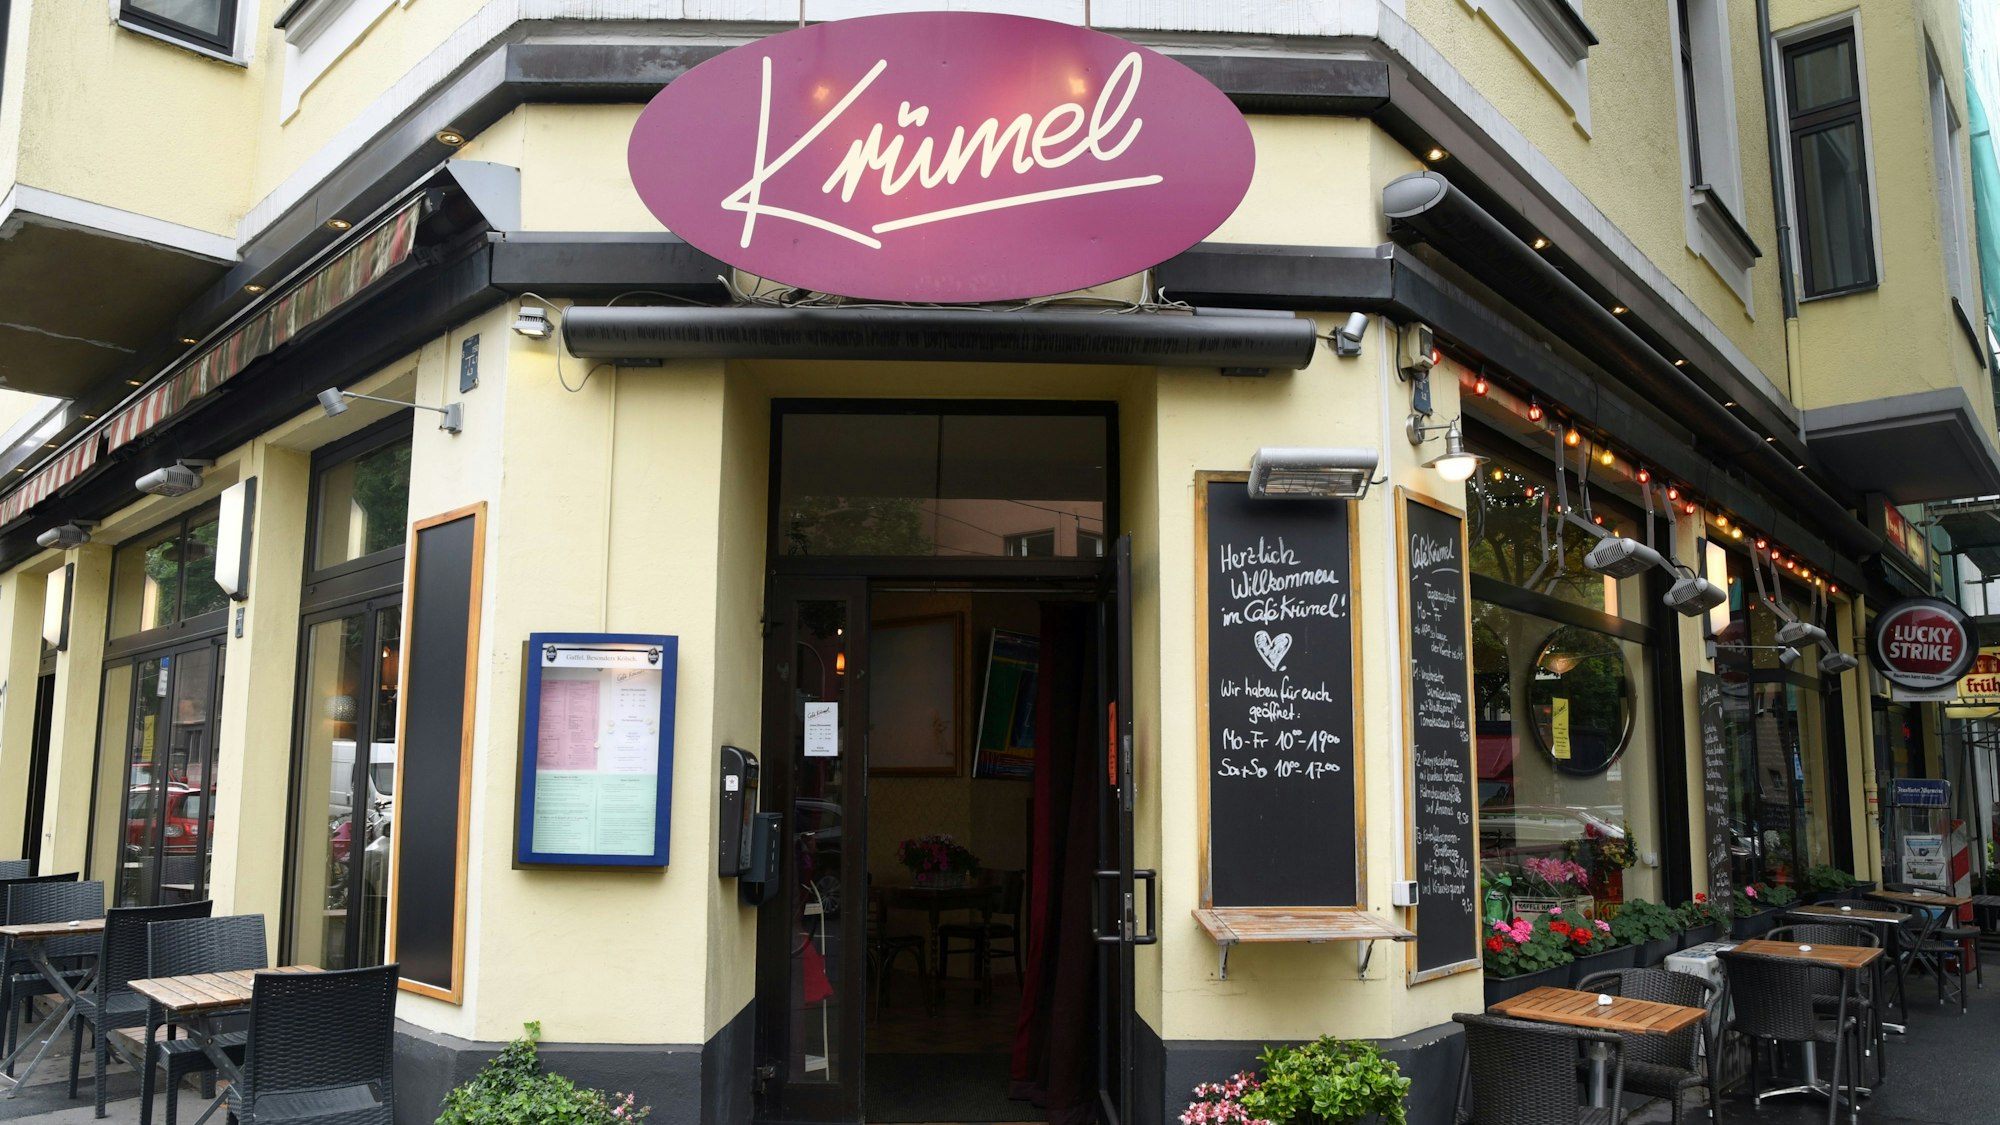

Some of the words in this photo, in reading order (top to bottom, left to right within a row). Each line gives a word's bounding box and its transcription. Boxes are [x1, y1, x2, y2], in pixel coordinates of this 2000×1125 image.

[721, 51, 1143, 249] Krümel
[1220, 536, 1301, 573] Herzlich
[1231, 568, 1339, 599] Willkommen
[1221, 607, 1243, 627] im
[1244, 597, 1279, 625] Café
[1279, 593, 1346, 621] Krümel!
[1894, 625, 1953, 643] LUCKY
[1889, 641, 1953, 662] STRIKE
[1220, 679, 1241, 697] Wir
[1244, 677, 1278, 698] haben
[1280, 675, 1301, 703] für
[1301, 681, 1332, 702] euch
[1248, 701, 1301, 724] geöffnet:
